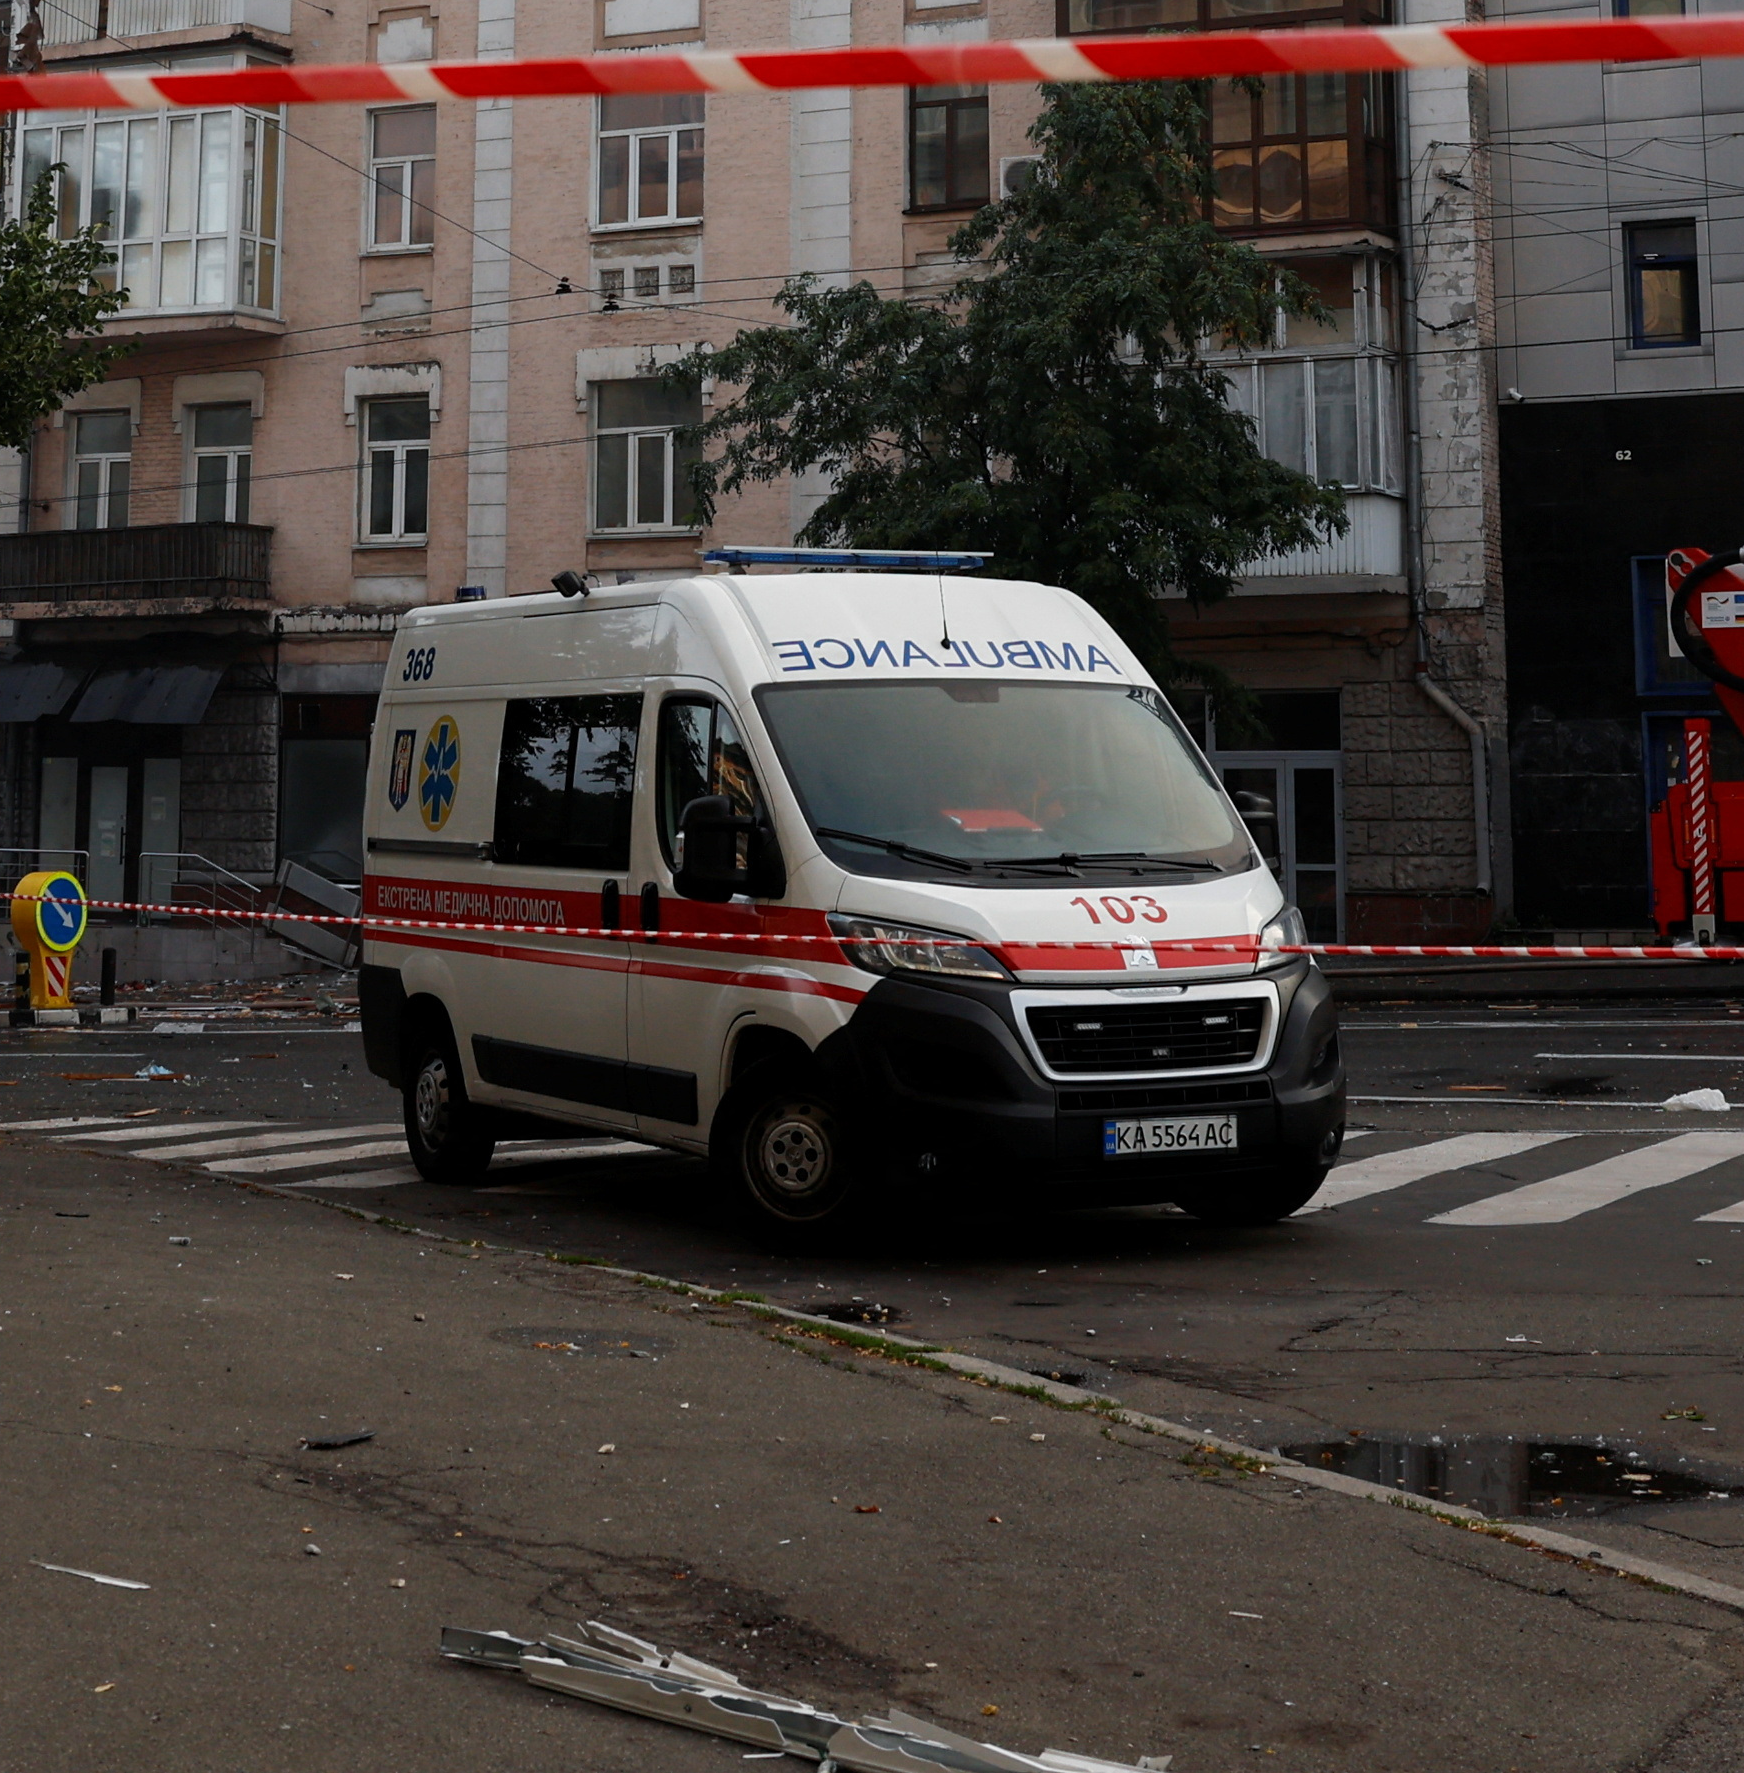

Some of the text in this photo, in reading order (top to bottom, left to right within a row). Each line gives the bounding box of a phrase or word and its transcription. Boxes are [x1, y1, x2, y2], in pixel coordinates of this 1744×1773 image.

[1615, 450, 1632, 461] 62
[402, 646, 436, 682] 368
[378, 885, 565, 926] ЕКСТРЕНА МЕДИЧНА ДОПОМОГА
[1069, 895, 1168, 924] 103
[1105, 1142, 1116, 1151] UA
[1117, 1122, 1233, 1150] KA 5564 AC
